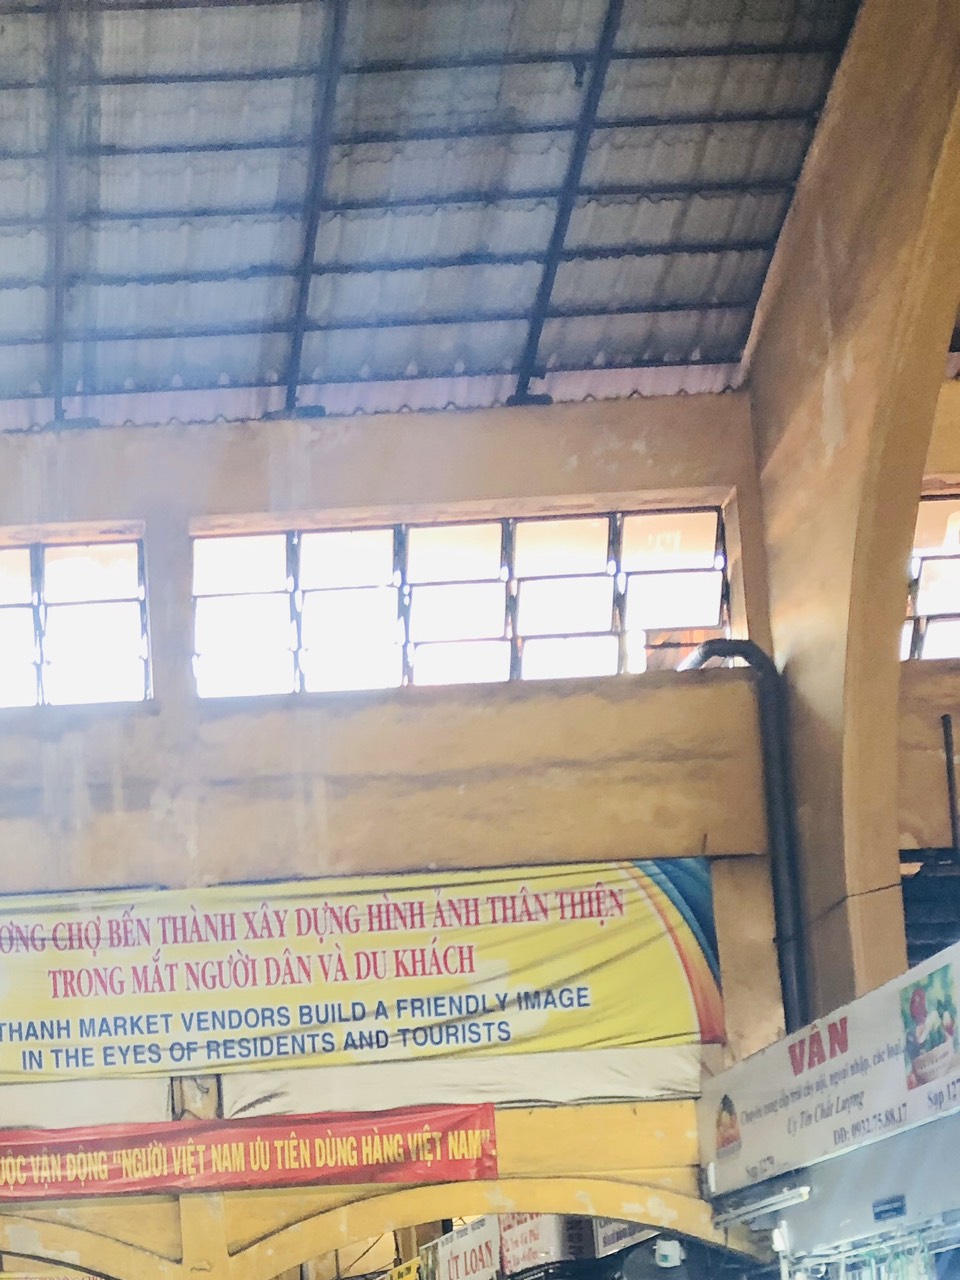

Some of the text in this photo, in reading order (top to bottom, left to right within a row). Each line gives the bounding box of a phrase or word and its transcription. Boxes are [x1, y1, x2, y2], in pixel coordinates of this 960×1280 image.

[51, 916, 102, 957] CHỢ
[107, 905, 151, 948] BẾN
[157, 904, 237, 945] THÀNH
[243, 902, 289, 940] XÂY
[295, 901, 361, 944] DỰNG
[366, 892, 426, 933] HÌNH
[486, 885, 549, 925] THÂN
[555, 881, 625, 928] THIỆN
[47, 937, 476, 999] TRONG MẮT NGƯỜI DÂN VÀ DU KHÁCH
[78, 1013, 173, 1039] MARKET
[180, 1006, 291, 1033] VENDORS
[298, 1001, 367, 1026] BUILD
[374, 1000, 389, 1020] A
[396, 993, 508, 1020] FRIENDLY
[516, 986, 591, 1011] IMAGE
[21, 1020, 512, 1071] IN THE EYES OF RESIDENTS AND TOURISTS
[787, 1015, 850, 1078] VÂN
[30, 1147, 62, 1190] VẬN
[66, 1144, 109, 1188] ĐỘNG
[171, 1137, 206, 1181] VIỆT
[210, 1141, 246, 1174] NAM
[249, 1135, 271, 1172] ƯU
[273, 1131, 311, 1170] TIÊN
[314, 1129, 359, 1169] DÙNG
[361, 1127, 405, 1166] HÀNG
[407, 1123, 442, 1168] VIỆT
[463, 1239, 495, 1277] LOAN
